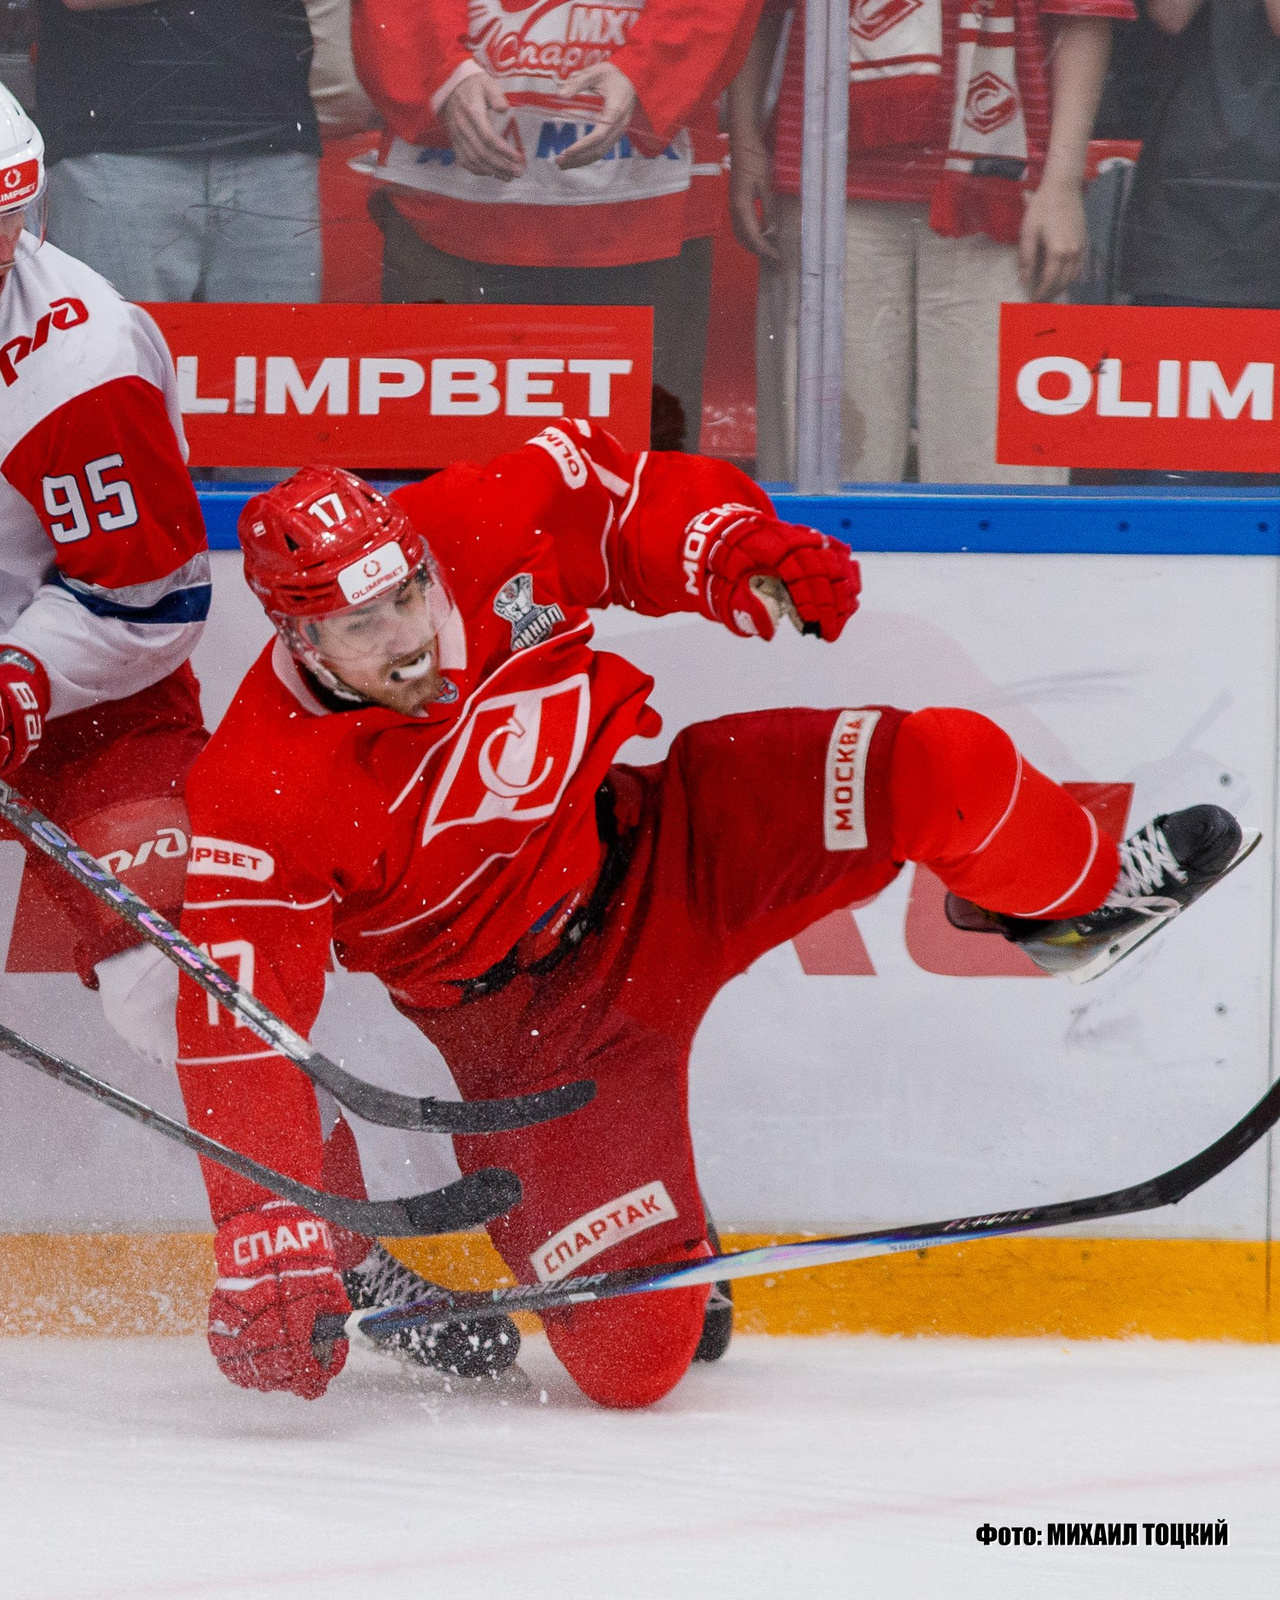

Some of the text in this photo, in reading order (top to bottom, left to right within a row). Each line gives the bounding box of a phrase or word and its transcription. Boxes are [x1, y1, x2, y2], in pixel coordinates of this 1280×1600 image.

[176, 355, 634, 417] LIMPBET
[42, 452, 139, 544] 95
[307, 492, 347, 528] 17
[351, 564, 405, 600] OLIMPBET
[834, 718, 864, 831] МОСКВА
[542, 1193, 663, 1274] СПАРТАК
